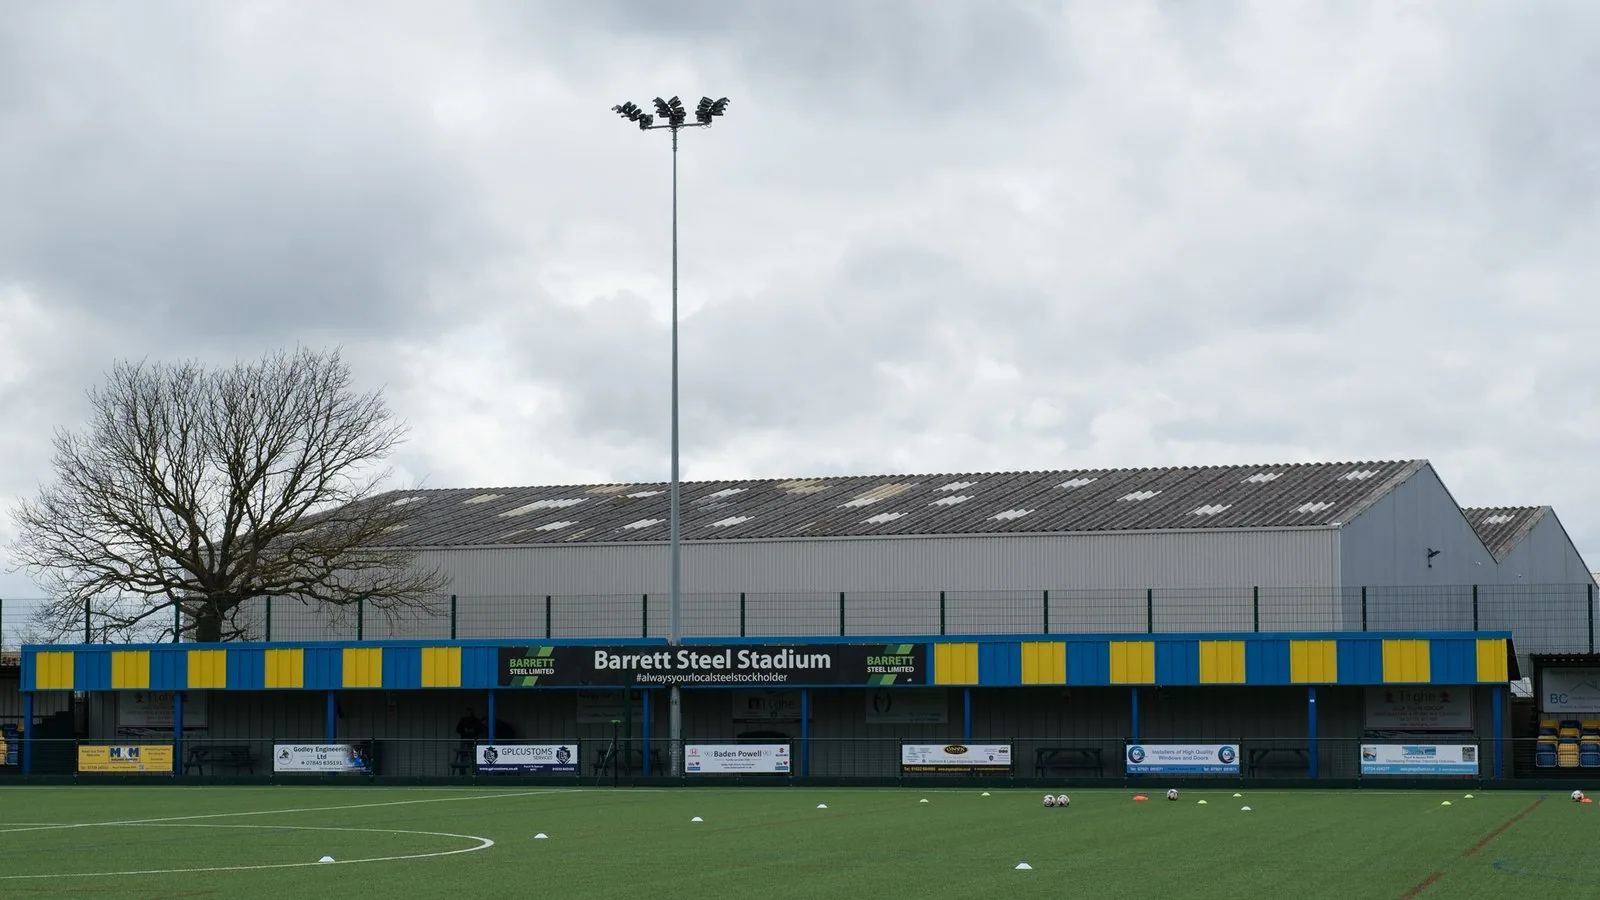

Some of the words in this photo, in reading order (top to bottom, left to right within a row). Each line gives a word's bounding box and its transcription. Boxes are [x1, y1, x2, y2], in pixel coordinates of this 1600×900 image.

[509, 658, 555, 668] BARRETT
[594, 650, 672, 670] Barrett
[677, 650, 732, 670] Steel
[737, 649, 831, 670] Stadium
[867, 655, 915, 665] BARRETT
[636, 672, 788, 684] #alwaysyourlocalsteelstockholder
[1550, 693, 1568, 704] BC
[109, 747, 140, 759] MKM
[501, 747, 553, 756] GPLCUSTOMS
